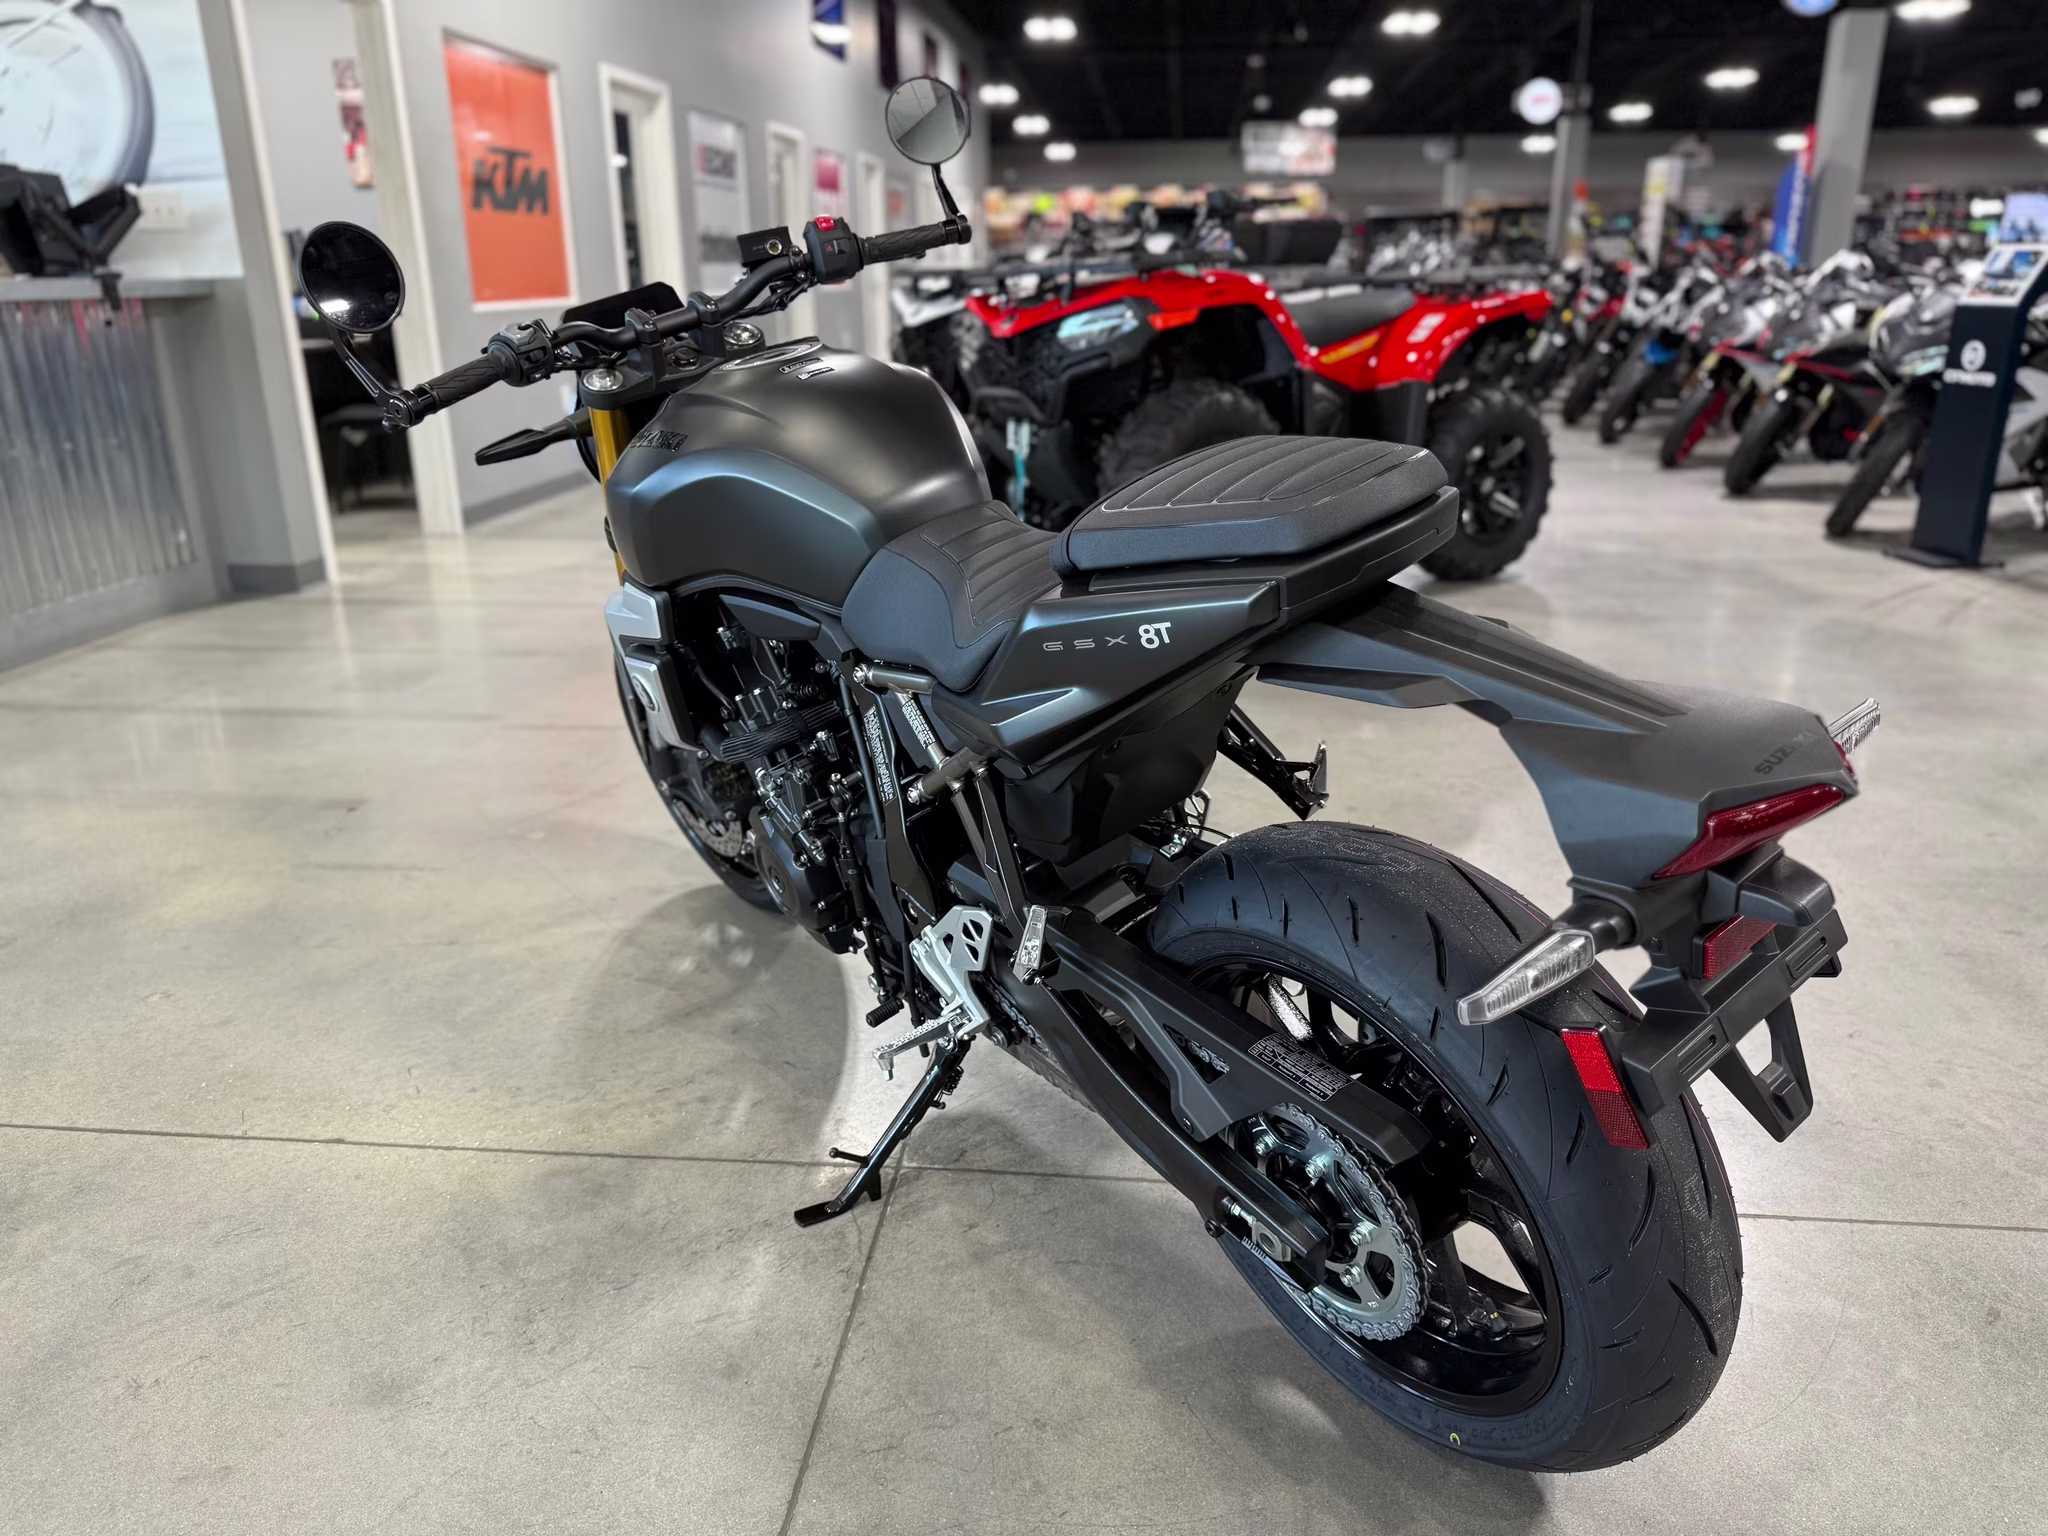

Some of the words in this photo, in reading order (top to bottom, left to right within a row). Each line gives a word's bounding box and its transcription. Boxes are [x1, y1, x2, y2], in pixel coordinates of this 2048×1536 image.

[472, 146, 549, 215] KTM
[1042, 634, 1129, 652] GSX
[1138, 621, 1172, 650] 8T
